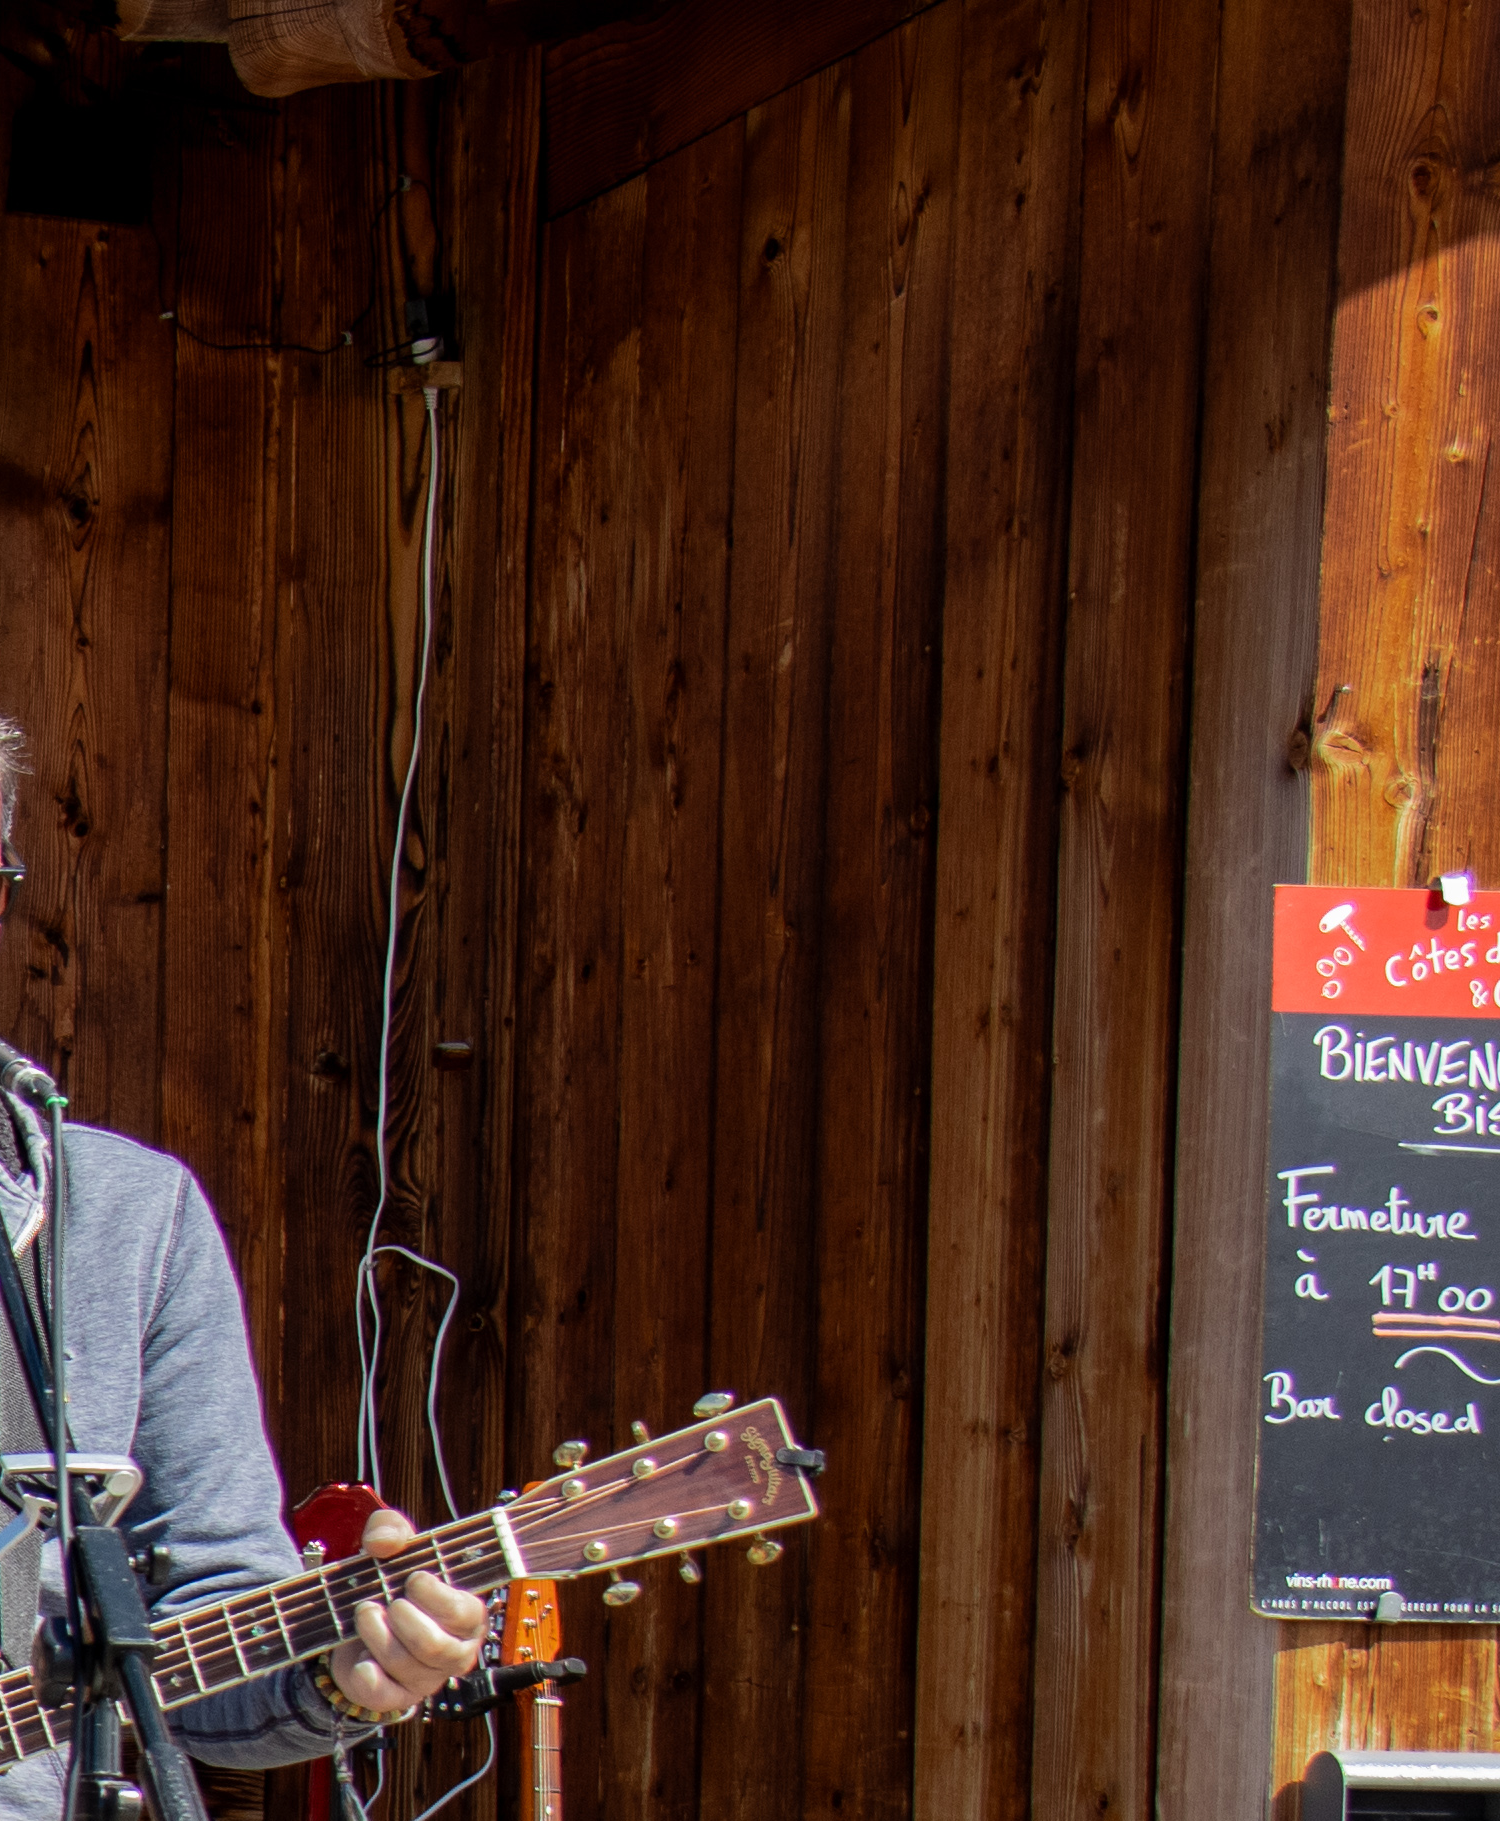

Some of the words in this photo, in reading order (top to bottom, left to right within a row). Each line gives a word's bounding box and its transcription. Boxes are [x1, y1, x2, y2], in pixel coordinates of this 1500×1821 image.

[1385, 936, 1477, 987] Côtes
[1276, 1165, 1477, 1240] Fermeture
[1294, 1249, 1329, 1302] à
[1264, 1371, 1340, 1426] Bar
